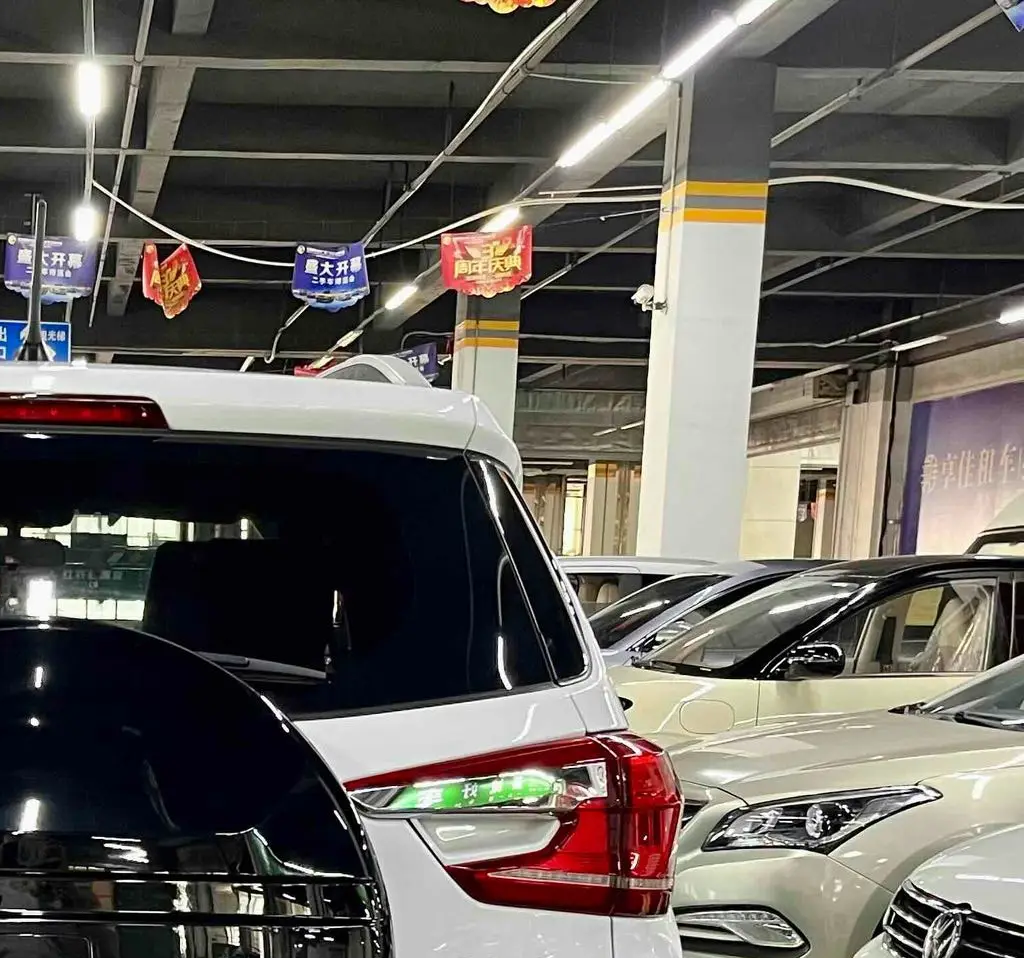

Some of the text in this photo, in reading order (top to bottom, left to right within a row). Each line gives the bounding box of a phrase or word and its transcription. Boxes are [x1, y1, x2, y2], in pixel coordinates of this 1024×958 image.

[304, 256, 363, 277] 盛大开幕
[454, 255, 522, 279] 周年庆典
